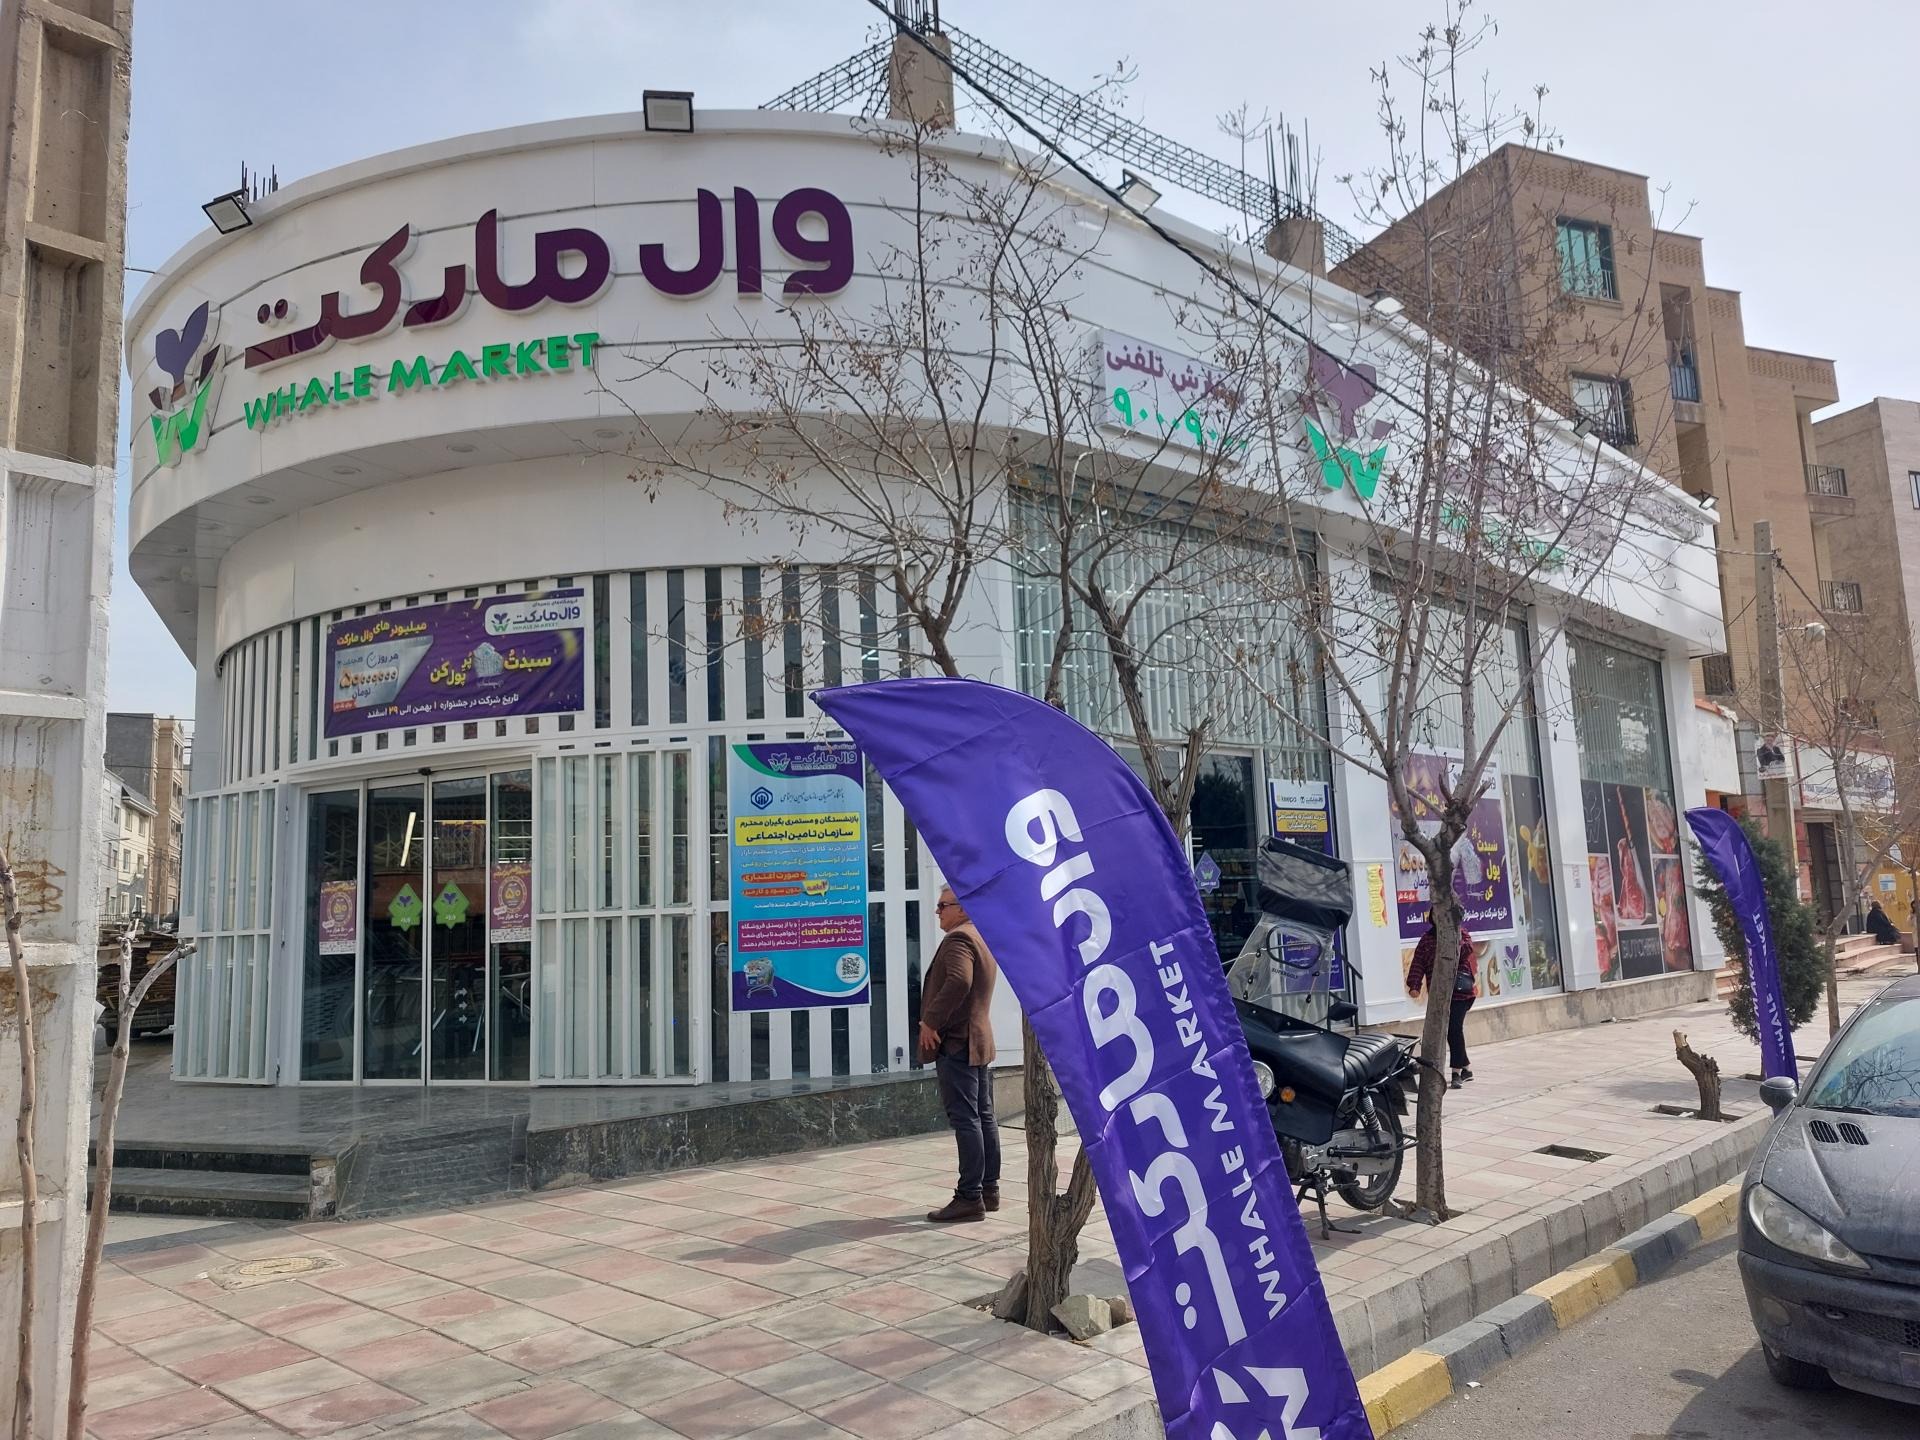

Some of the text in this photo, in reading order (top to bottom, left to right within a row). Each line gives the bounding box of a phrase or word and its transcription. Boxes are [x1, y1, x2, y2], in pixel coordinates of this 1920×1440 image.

[245, 186, 854, 369] وال مارکت
[1106, 345, 1163, 378] تلفنی
[244, 331, 601, 430] WHALE MARKET
[513, 606, 580, 625] وال مارکت
[446, 669, 467, 687] پول
[440, 700, 468, 711] جشنواره
[469, 699, 478, 708] در
[478, 696, 501, 707] شرکت
[502, 694, 519, 706] تاریخ
[367, 707, 388, 719] اسفند
[399, 705, 412, 716] الی
[411, 704, 432, 714] بهمن
[837, 751, 858, 765] وال
[740, 820, 763, 828] محترم
[764, 818, 785, 827] بگیران
[785, 818, 814, 826] مستمری
[820, 815, 859, 824] بازنشستگان
[746, 828, 854, 842] سازمان تامین اجتماعی
[1487, 859, 1501, 881] پول
[1406, 911, 1423, 924] اسفند
[1463, 906, 1479, 922] جشنوار
[1485, 908, 1498, 919] شرکت
[1497, 907, 1508, 920] تاریخ
[801, 927, 846, 936] club.sfara.ir
[1005, 788, 1248, 1347] وال مارکت
[1149, 939, 1287, 1320] WHALE MARKET
